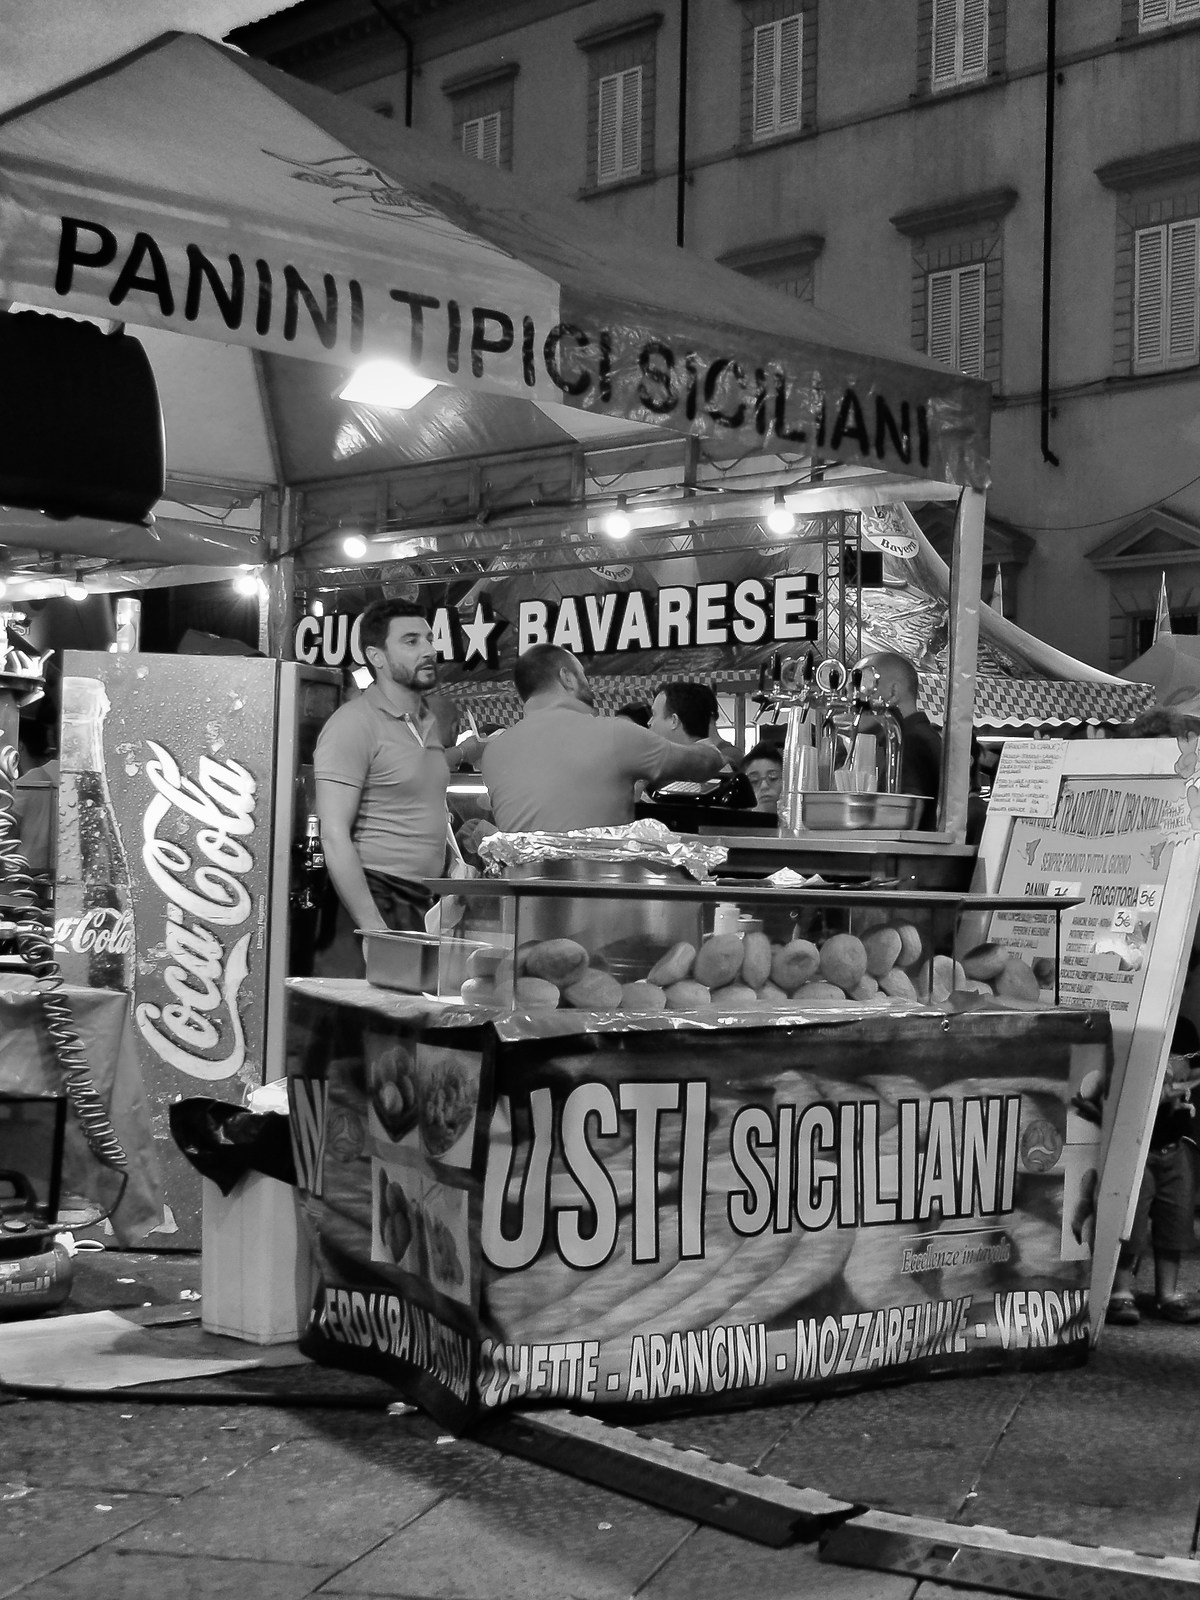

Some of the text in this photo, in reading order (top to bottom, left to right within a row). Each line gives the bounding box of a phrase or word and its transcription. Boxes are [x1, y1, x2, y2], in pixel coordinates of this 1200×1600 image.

[54, 216, 931, 468] PANINI TIPICI SICILIANI
[880, 538, 917, 556] Bayern
[596, 565, 632, 578] Bayern
[519, 575, 807, 657] BAVARESE
[1024, 882, 1050, 896] PANINI
[1089, 885, 1140, 907] FRIGGITORIA
[1138, 890, 1157, 907] 5€
[135, 739, 257, 1081] Coca-Cola
[1114, 911, 1131, 927] 3€
[727, 1095, 1022, 1237] SICILIANI
[901, 1236, 1011, 1274] Eccellenze in tavola
[626, 1322, 768, 1402] ARANCINI
[793, 1295, 973, 1381] MOZZARELLINE
